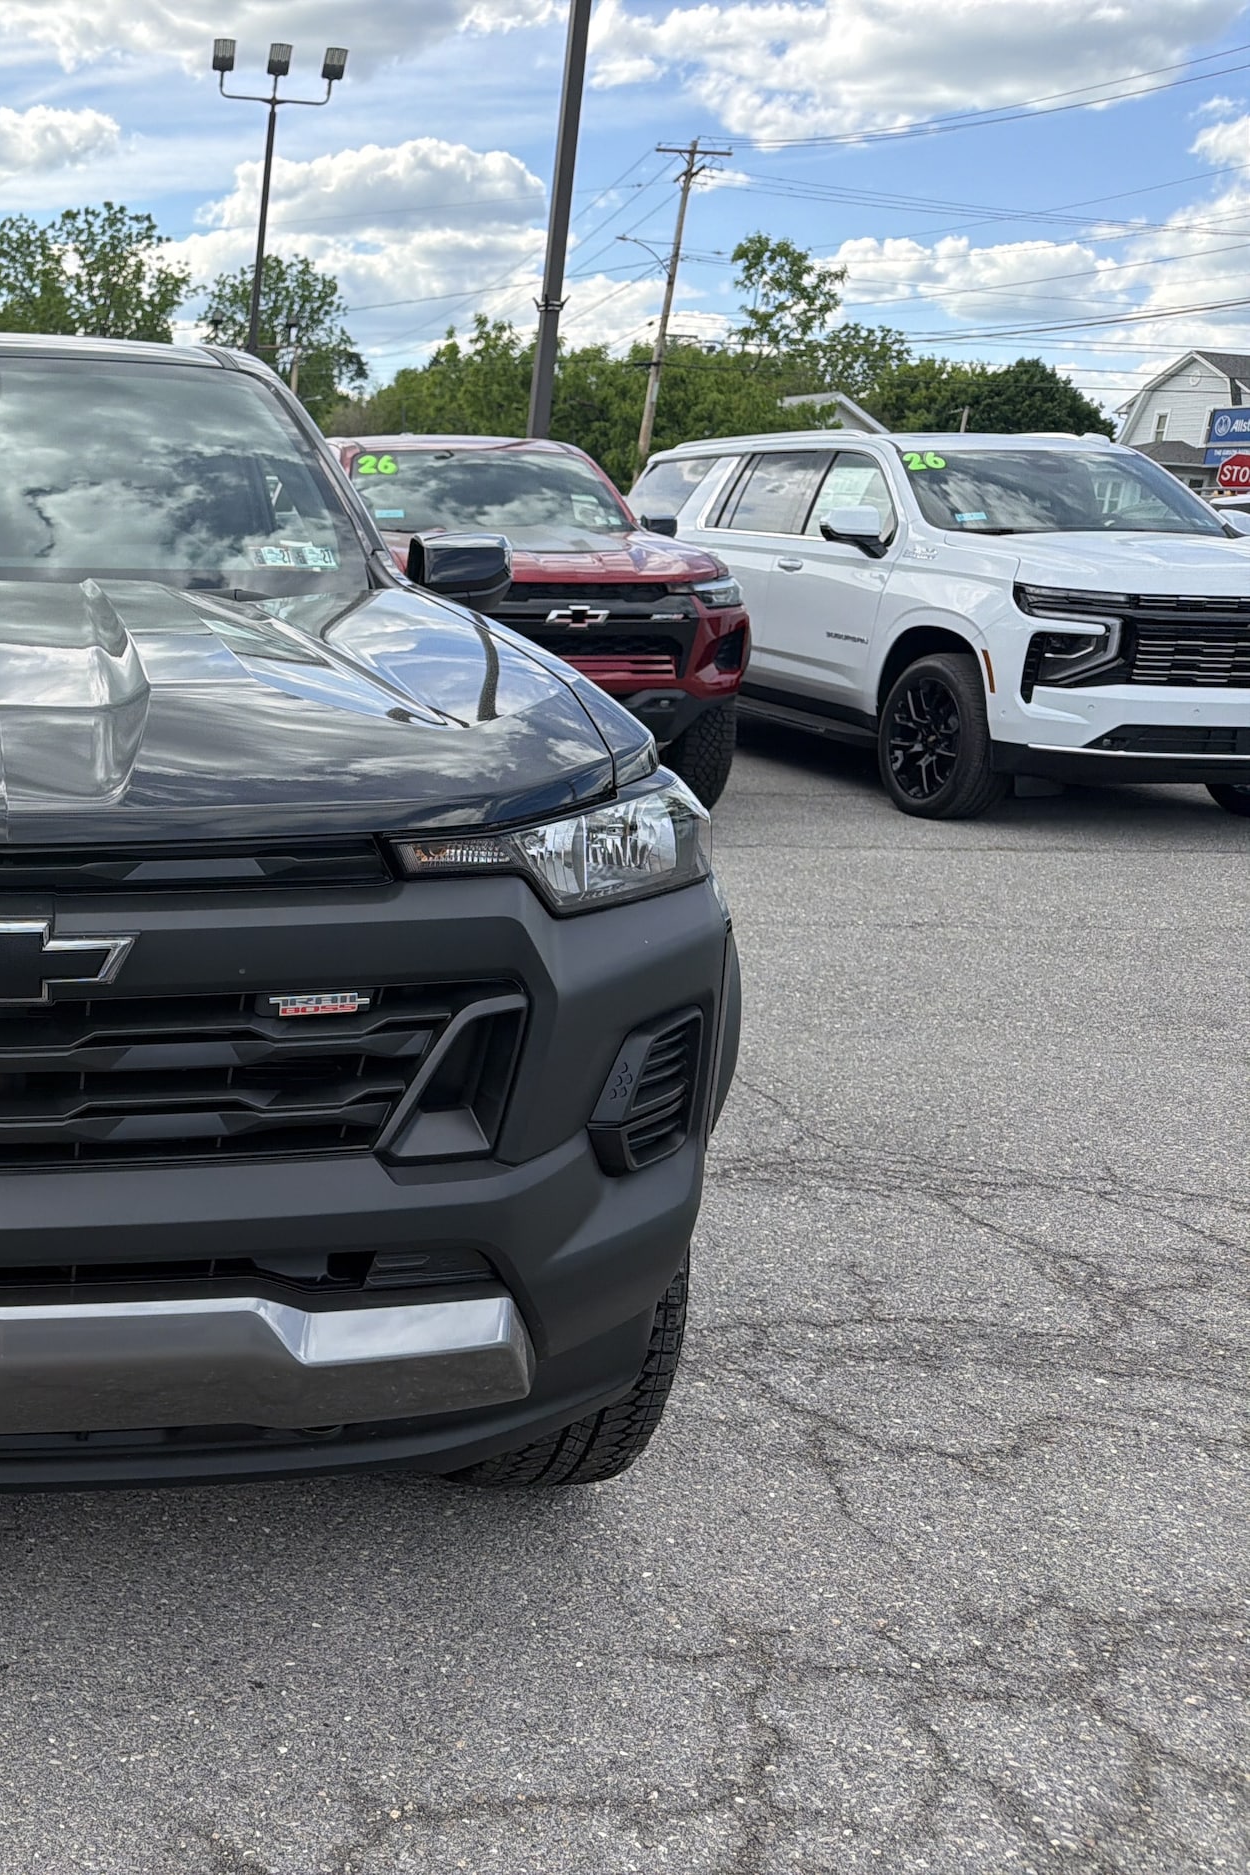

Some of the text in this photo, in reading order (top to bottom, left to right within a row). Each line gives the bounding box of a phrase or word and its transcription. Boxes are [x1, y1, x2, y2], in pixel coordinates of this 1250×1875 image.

[358, 454, 398, 475] 26
[903, 451, 946, 471] 26
[1220, 465, 1250, 483] STO
[269, 992, 370, 1006] TRAIL
[280, 1003, 358, 1016] BOSS
